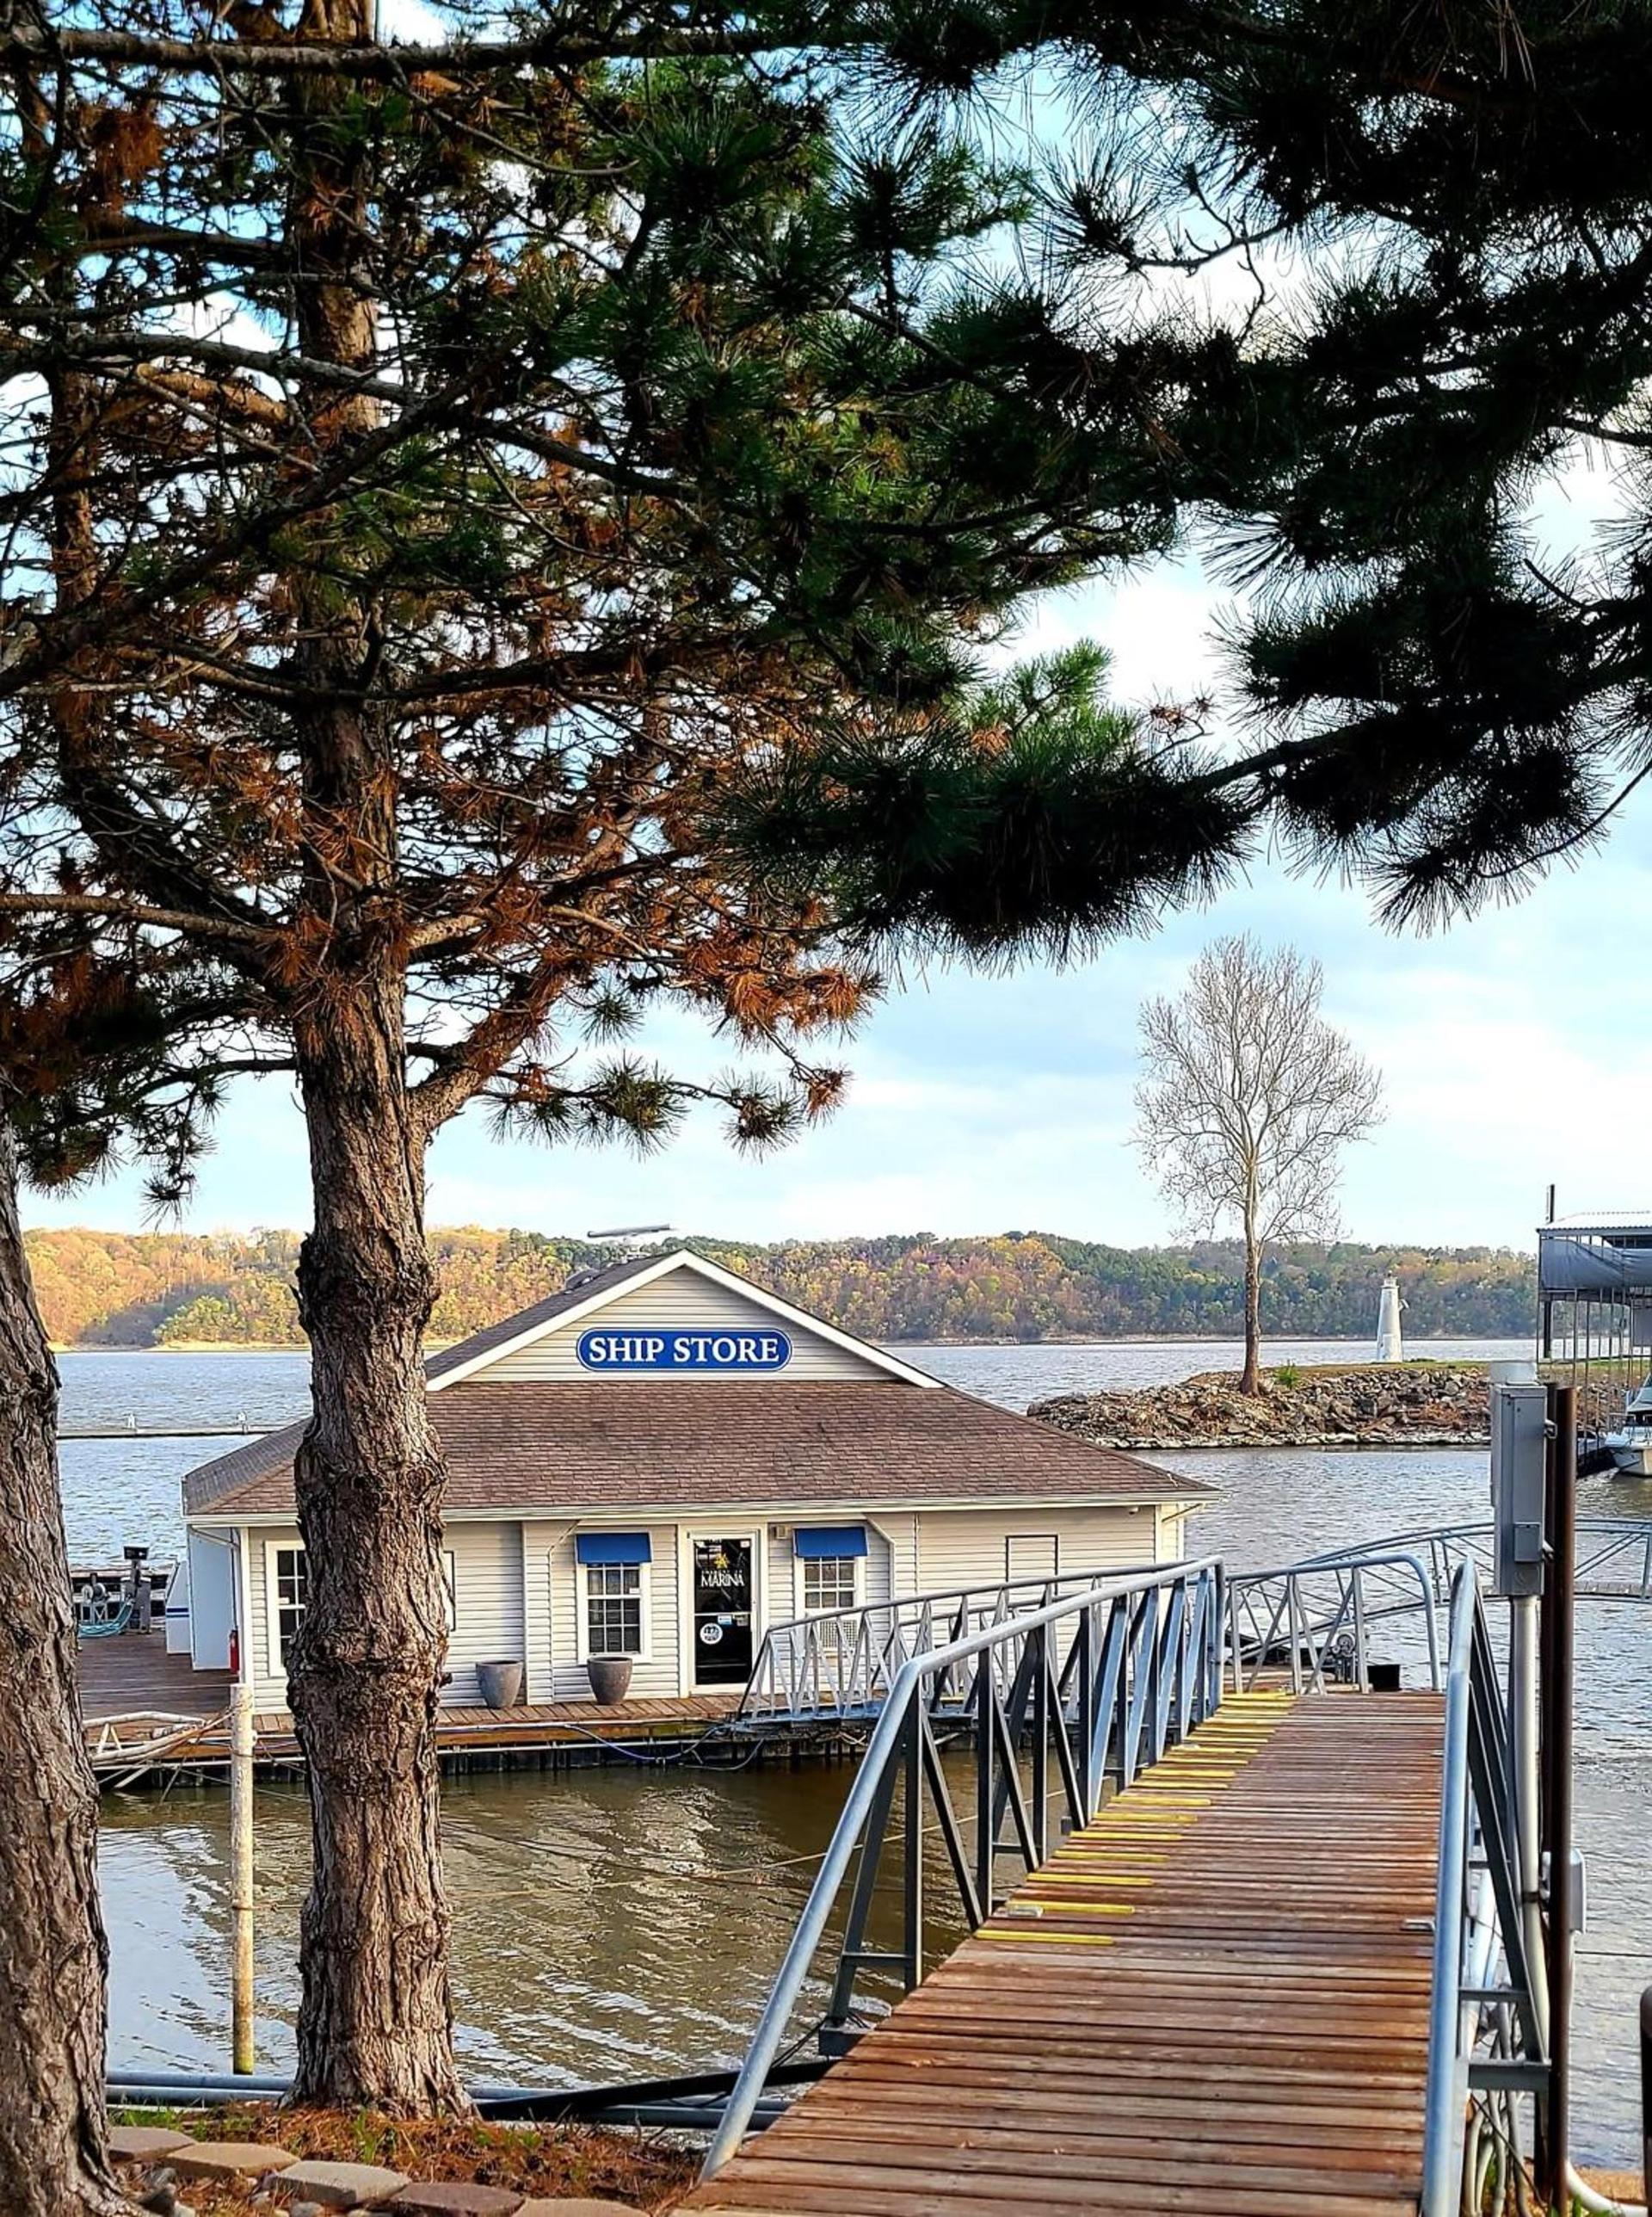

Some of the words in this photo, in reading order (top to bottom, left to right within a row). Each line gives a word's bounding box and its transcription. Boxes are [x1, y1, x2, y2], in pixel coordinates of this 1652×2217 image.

[589, 1337, 665, 1362] SHIP
[673, 1337, 780, 1363] STORE
[701, 1573, 745, 1586] MARINA
